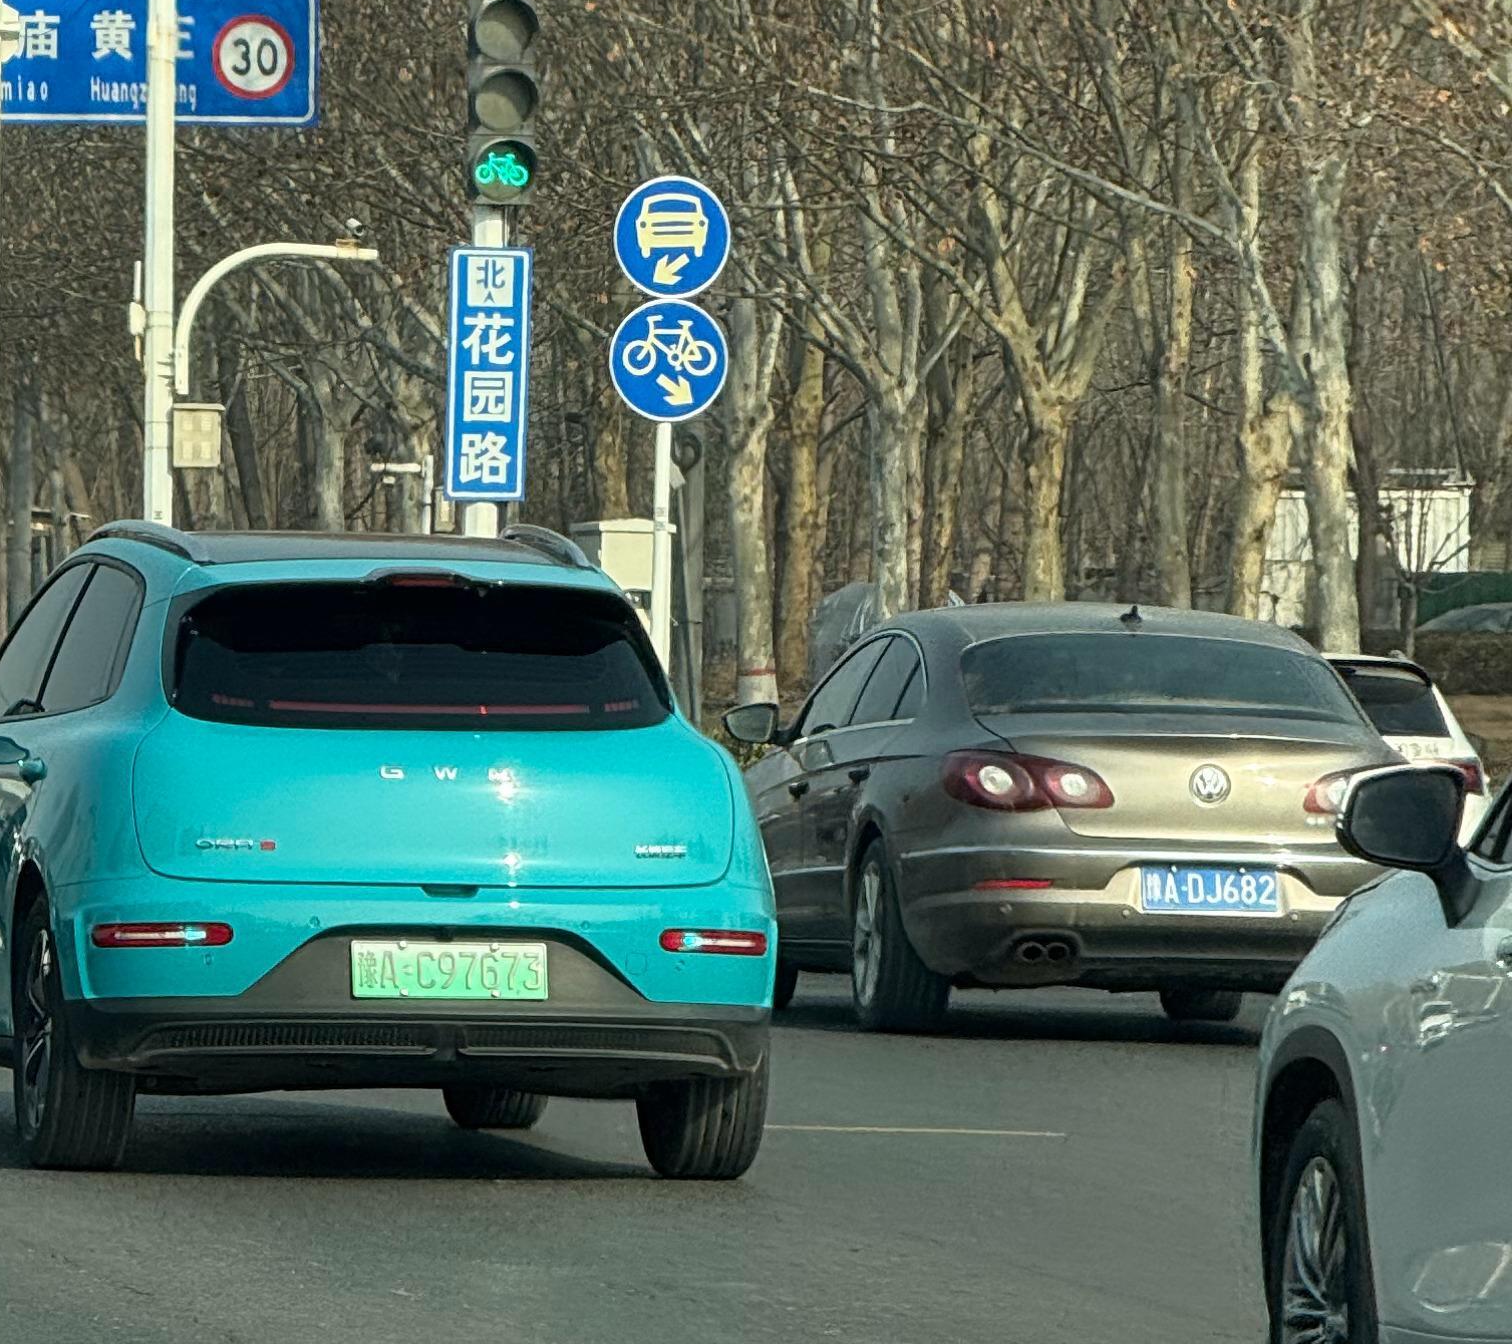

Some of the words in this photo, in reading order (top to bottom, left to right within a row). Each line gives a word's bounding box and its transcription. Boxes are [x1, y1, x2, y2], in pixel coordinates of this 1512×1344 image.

[230, 38, 279, 77] 30
[477, 259, 506, 290] 北
[459, 312, 515, 485] 花园路
